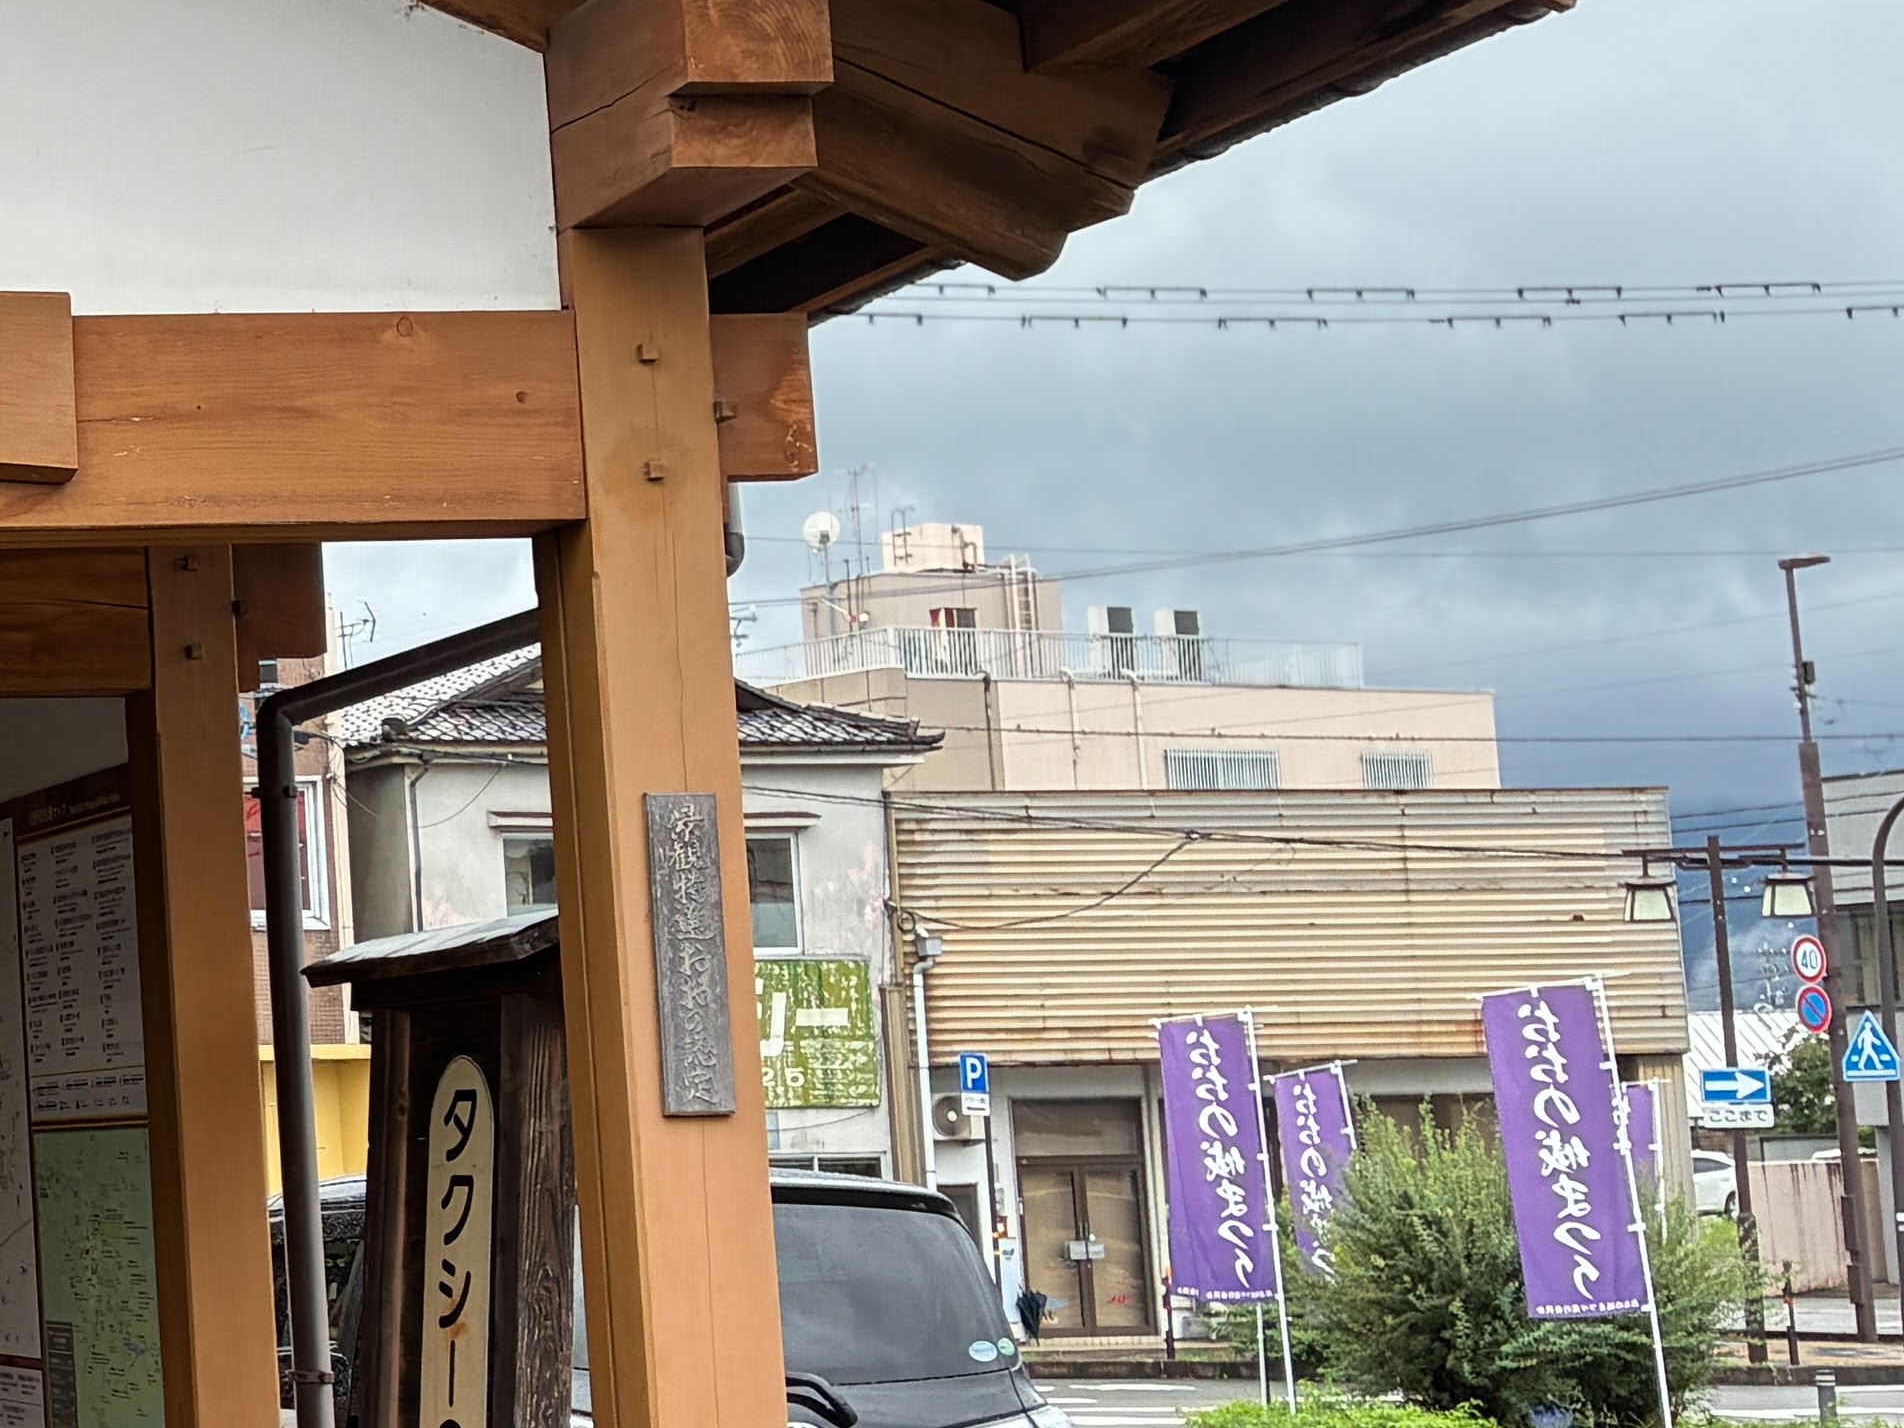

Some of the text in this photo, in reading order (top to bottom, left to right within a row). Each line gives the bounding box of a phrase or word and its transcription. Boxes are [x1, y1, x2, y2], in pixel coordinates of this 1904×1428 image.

[1800, 948, 1819, 970] 40
[965, 1057, 982, 1089] P
[1708, 1109, 1768, 1123] ここまで
